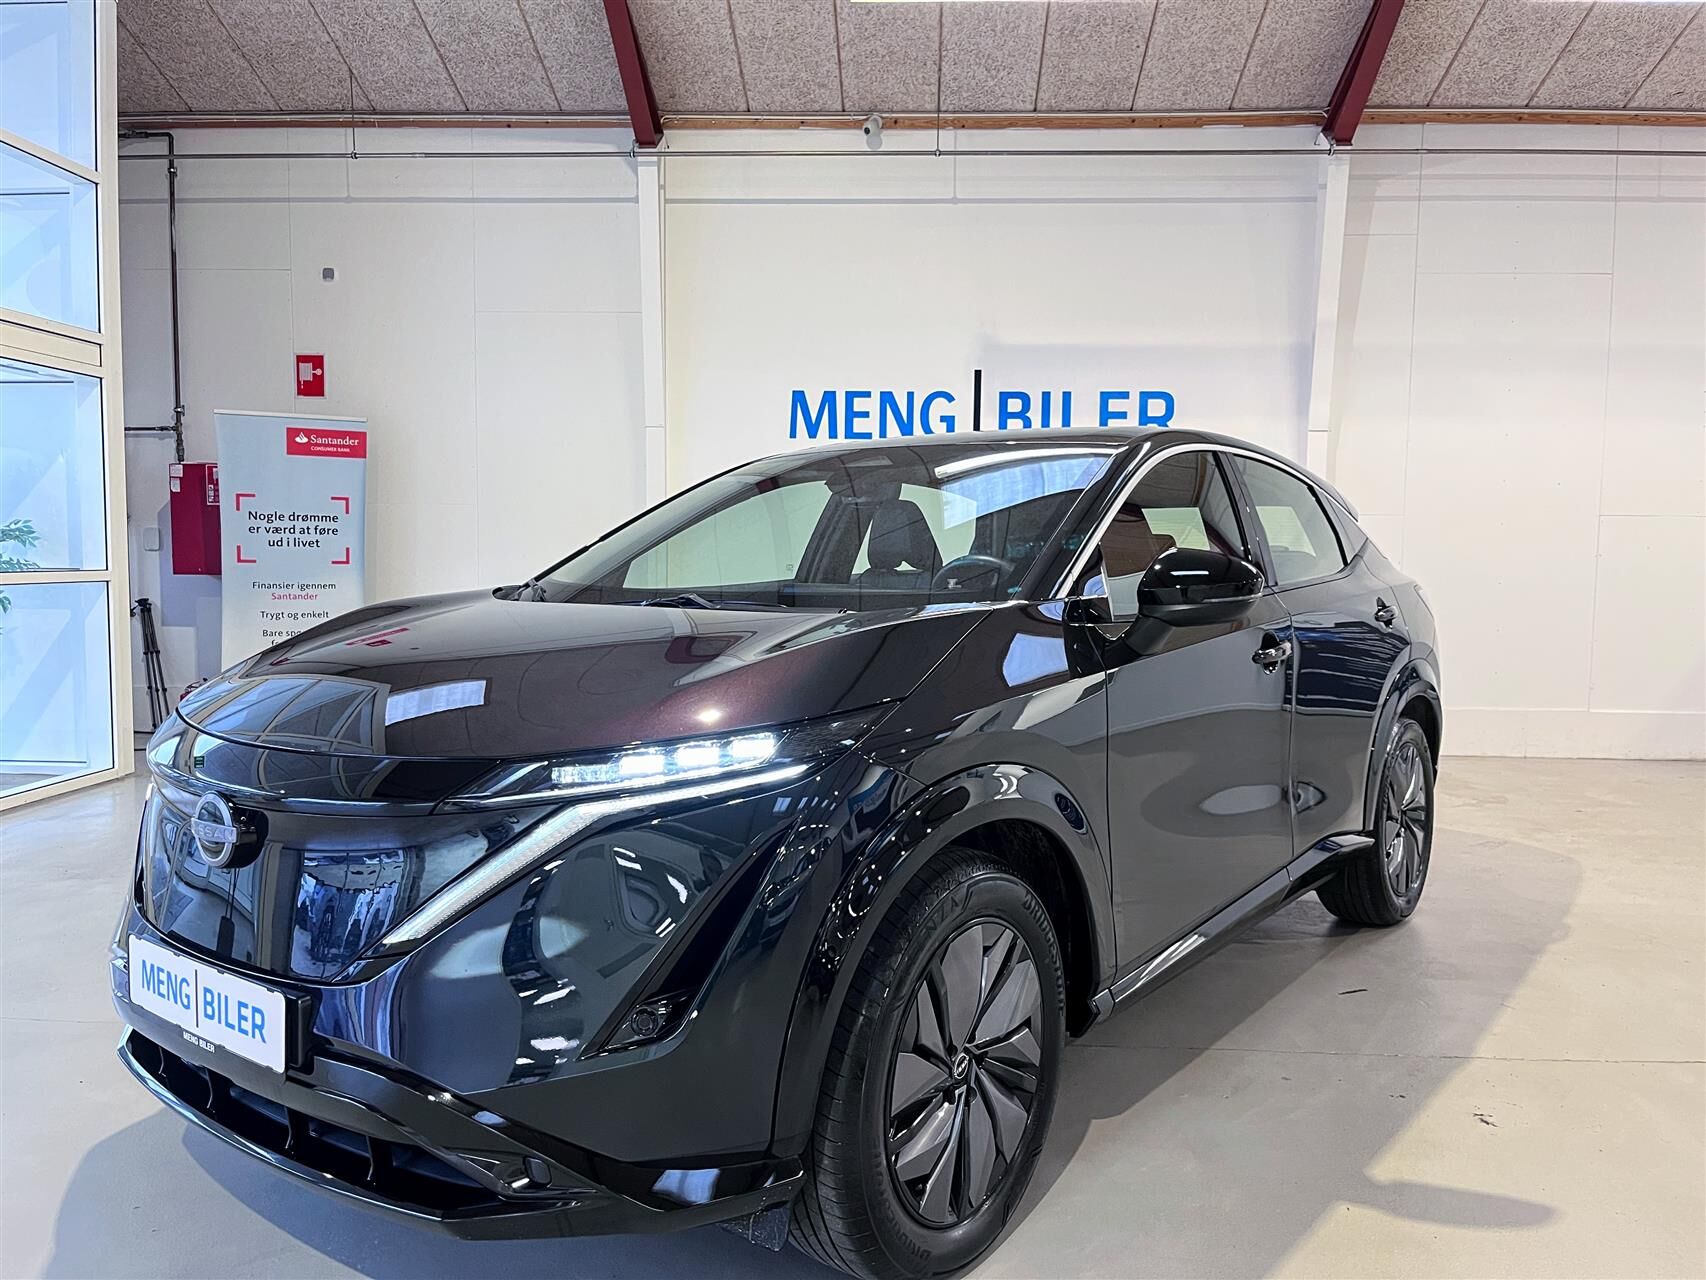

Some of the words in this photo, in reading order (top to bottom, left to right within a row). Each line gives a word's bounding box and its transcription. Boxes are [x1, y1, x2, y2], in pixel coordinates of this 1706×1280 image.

[789, 390, 956, 440] MENG
[310, 434, 360, 446] Santander
[248, 510, 285, 524] Nogle
[288, 511, 339, 523] drømme
[248, 525, 261, 534] er
[264, 524, 296, 535] værd
[299, 525, 311, 535] at
[314, 525, 339, 536] føre
[268, 537, 283, 547] ud
[293, 537, 321, 548] livet
[252, 581, 295, 590] Finansier
[297, 581, 337, 591] igennem
[271, 592, 318, 600] Santander
[260, 610, 285, 620] Trygt
[287, 612, 299, 620] og
[301, 610, 329, 619] enkelt
[262, 629, 283, 637] Bare
[141, 959, 191, 1010] MENG
[203, 986, 267, 1044] BILER
[183, 1031, 198, 1046] MENG
[198, 1039, 215, 1053] BILER
